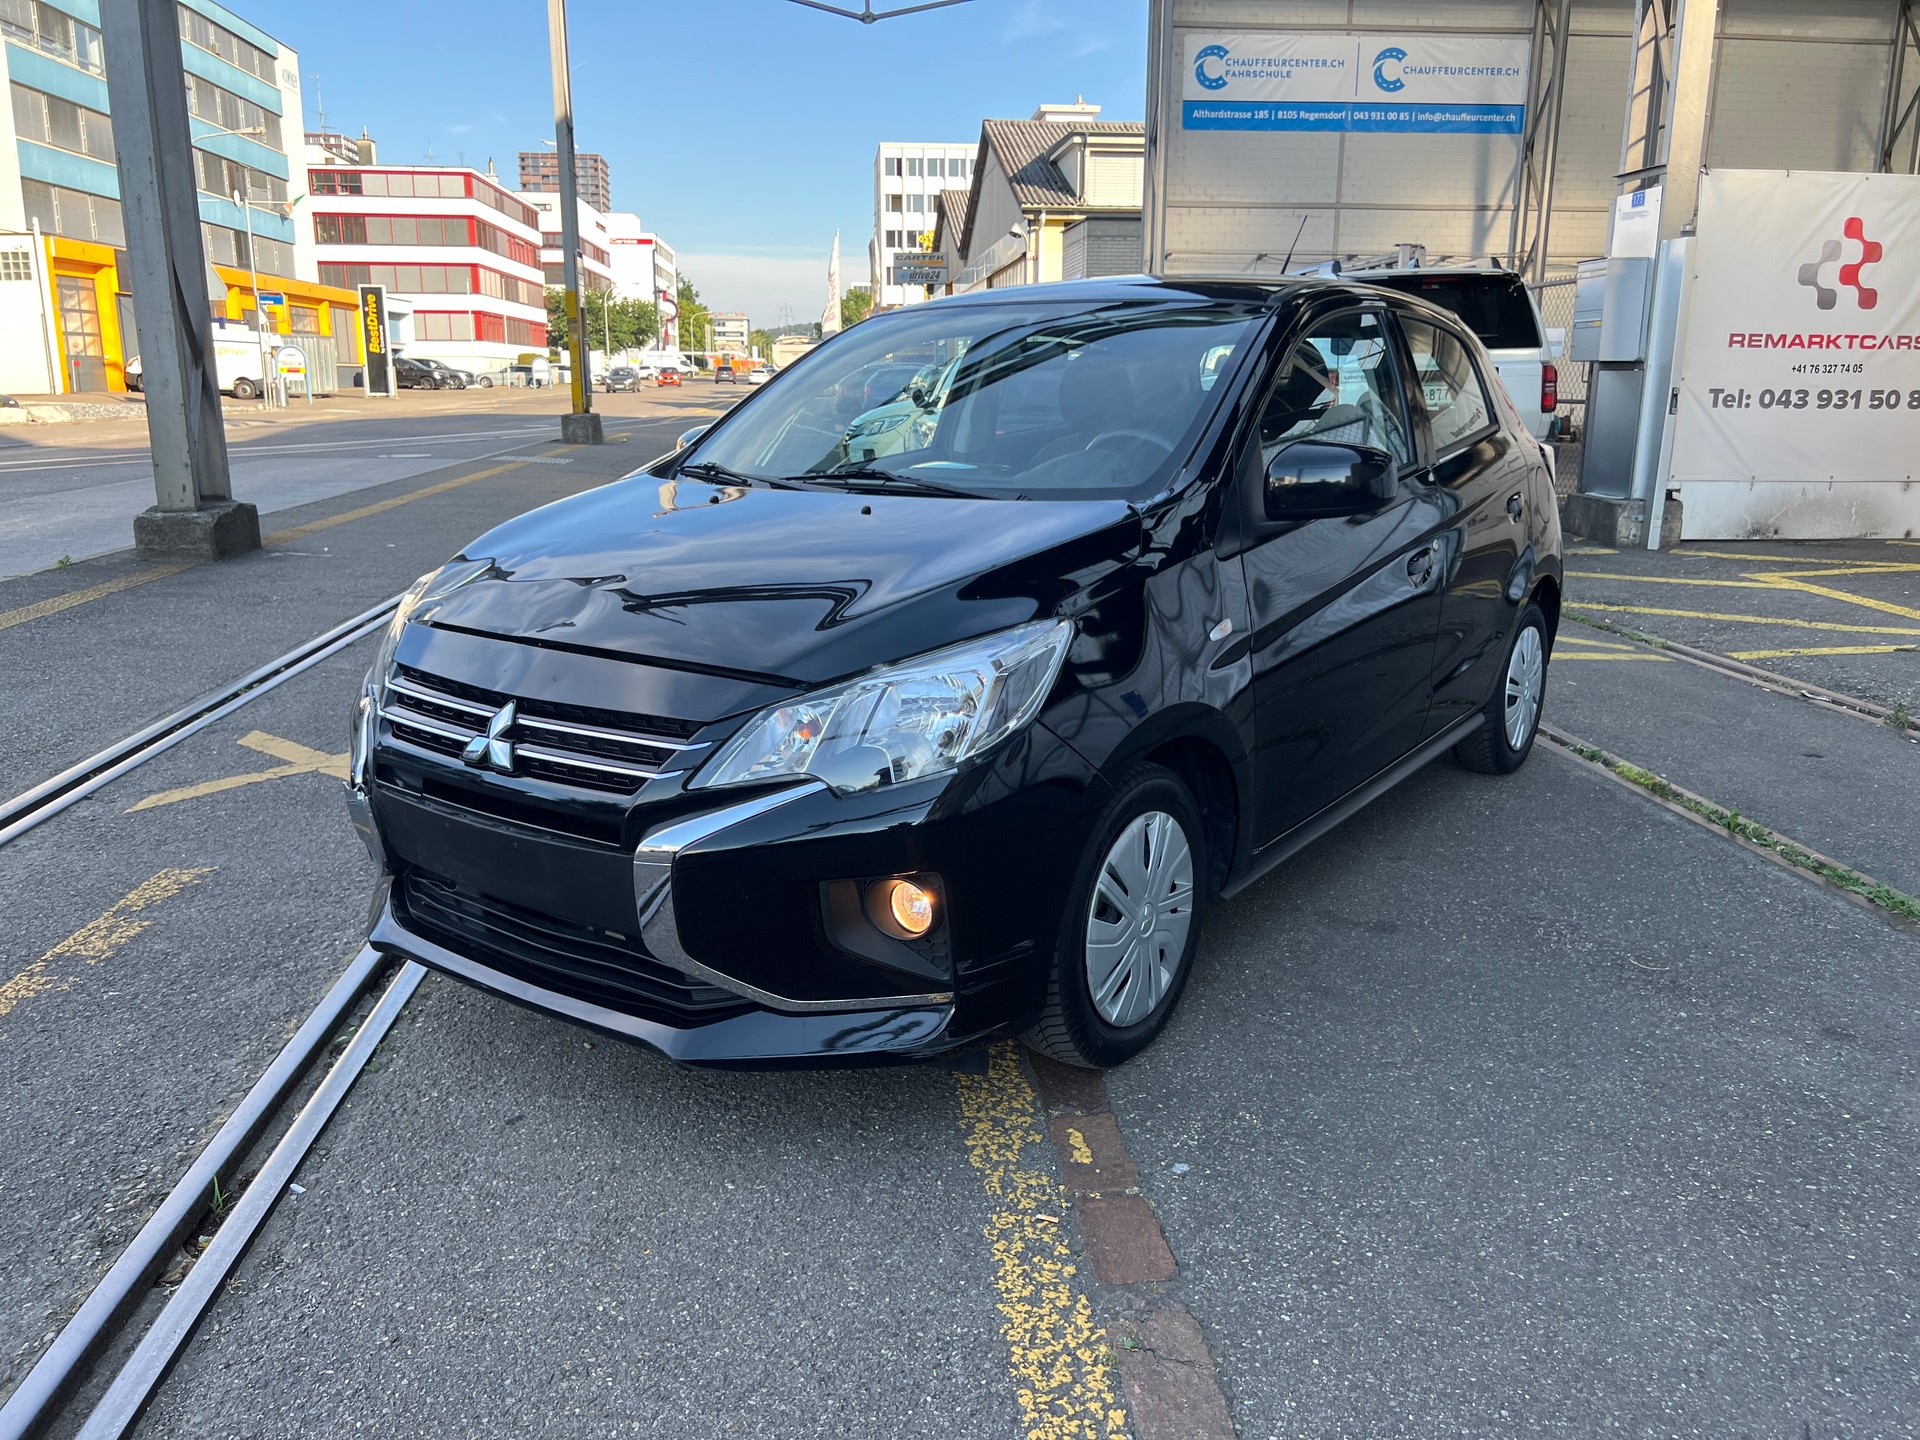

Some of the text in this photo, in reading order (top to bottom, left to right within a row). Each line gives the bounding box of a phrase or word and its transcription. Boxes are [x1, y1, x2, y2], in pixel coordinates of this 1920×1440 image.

[1225, 58, 1345, 68] CHAUFFEURCENTER.CH
[1225, 70, 1292, 78] FAHRSCHULE
[1402, 66, 1520, 76] CHAUFFEURCENTER.CH
[1192, 109, 1516, 122] Althardstrasse 185 8105 Regensdorf 043 931 00 85 info@chauffeurcenter.ch
[364, 293, 380, 354] BestDrive
[1792, 364, 1863, 374] +41 76 327 74 05
[1709, 388, 1752, 409] Tel:
[1759, 389, 1810, 409] 043
[1817, 389, 1862, 410] 931
[1869, 390, 1901, 410] 50
